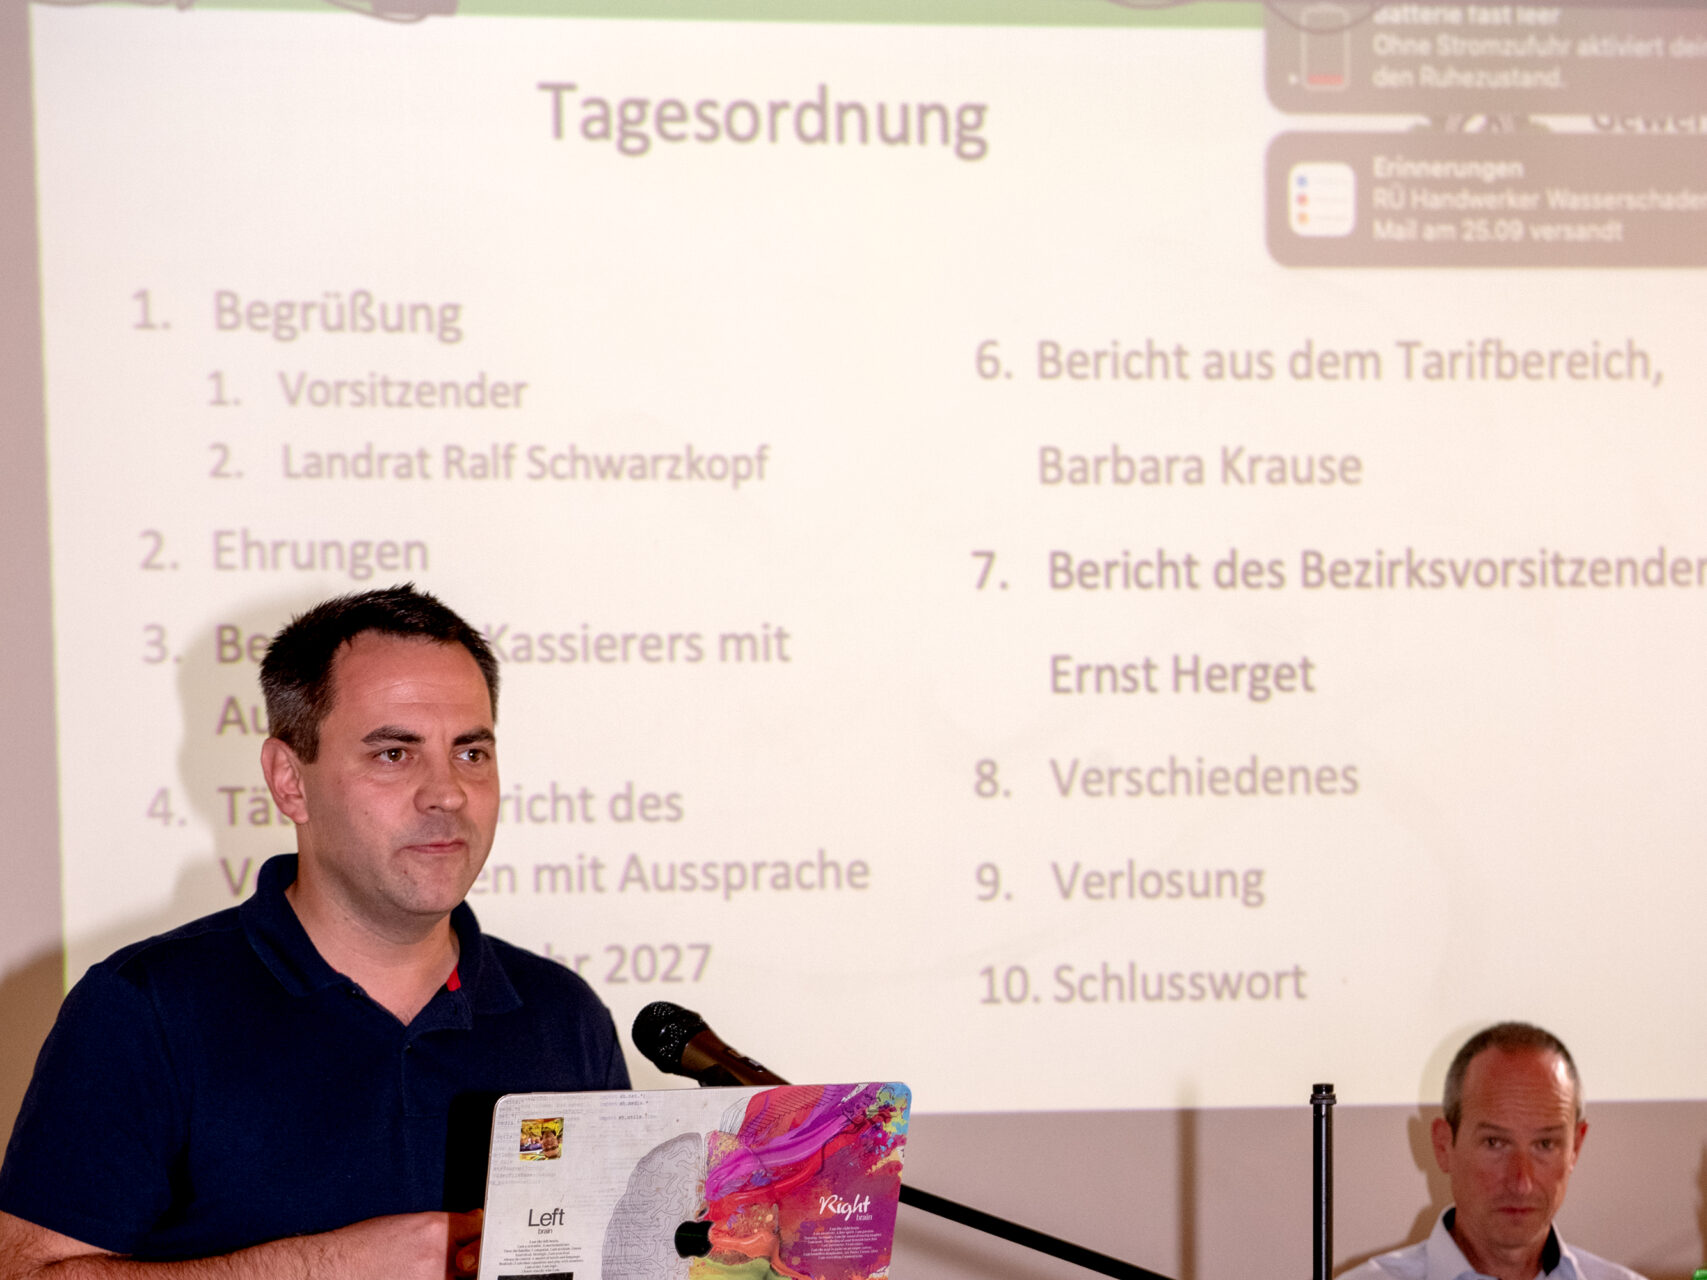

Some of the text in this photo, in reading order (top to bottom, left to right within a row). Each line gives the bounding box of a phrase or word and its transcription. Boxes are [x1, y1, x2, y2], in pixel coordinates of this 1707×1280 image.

[1372, 33, 1432, 56] Ohne
[1372, 66, 1413, 87] den
[537, 82, 988, 161] Tagesordnung
[1372, 156, 1524, 183] Erinnerungen
[1410, 189, 1539, 210] Handwerker
[1373, 219, 1622, 241] Mail am 25.09 versandt
[132, 288, 463, 343] 1. Begrüßung
[975, 338, 1663, 387] 6. Bericht aus dem Tarifbereich,
[208, 370, 527, 409] 1. Vorsitzender
[209, 442, 769, 490] 2. Landrat Ralf Schwarzkopf
[1039, 443, 1362, 485] Barbara Krause
[140, 529, 429, 579] 2. Ehrungen
[971, 550, 1007, 590] 7.
[1049, 548, 1199, 590] Bericht
[1213, 548, 1285, 589] des
[143, 622, 182, 665] 3.
[719, 623, 790, 662] mit
[1051, 654, 1315, 703] Ernst Herget
[974, 754, 1359, 798] 8. Verschiedenes
[147, 786, 186, 827] 4.
[608, 781, 683, 823] des
[533, 853, 605, 893] mit
[617, 848, 869, 901] Aussprache
[975, 859, 1265, 908] 9. Verlosung
[604, 943, 711, 985] 2027
[980, 961, 1307, 1004] 10. Schlusswort
[528, 1207, 565, 1227] Left
[819, 1193, 871, 1221] Right
